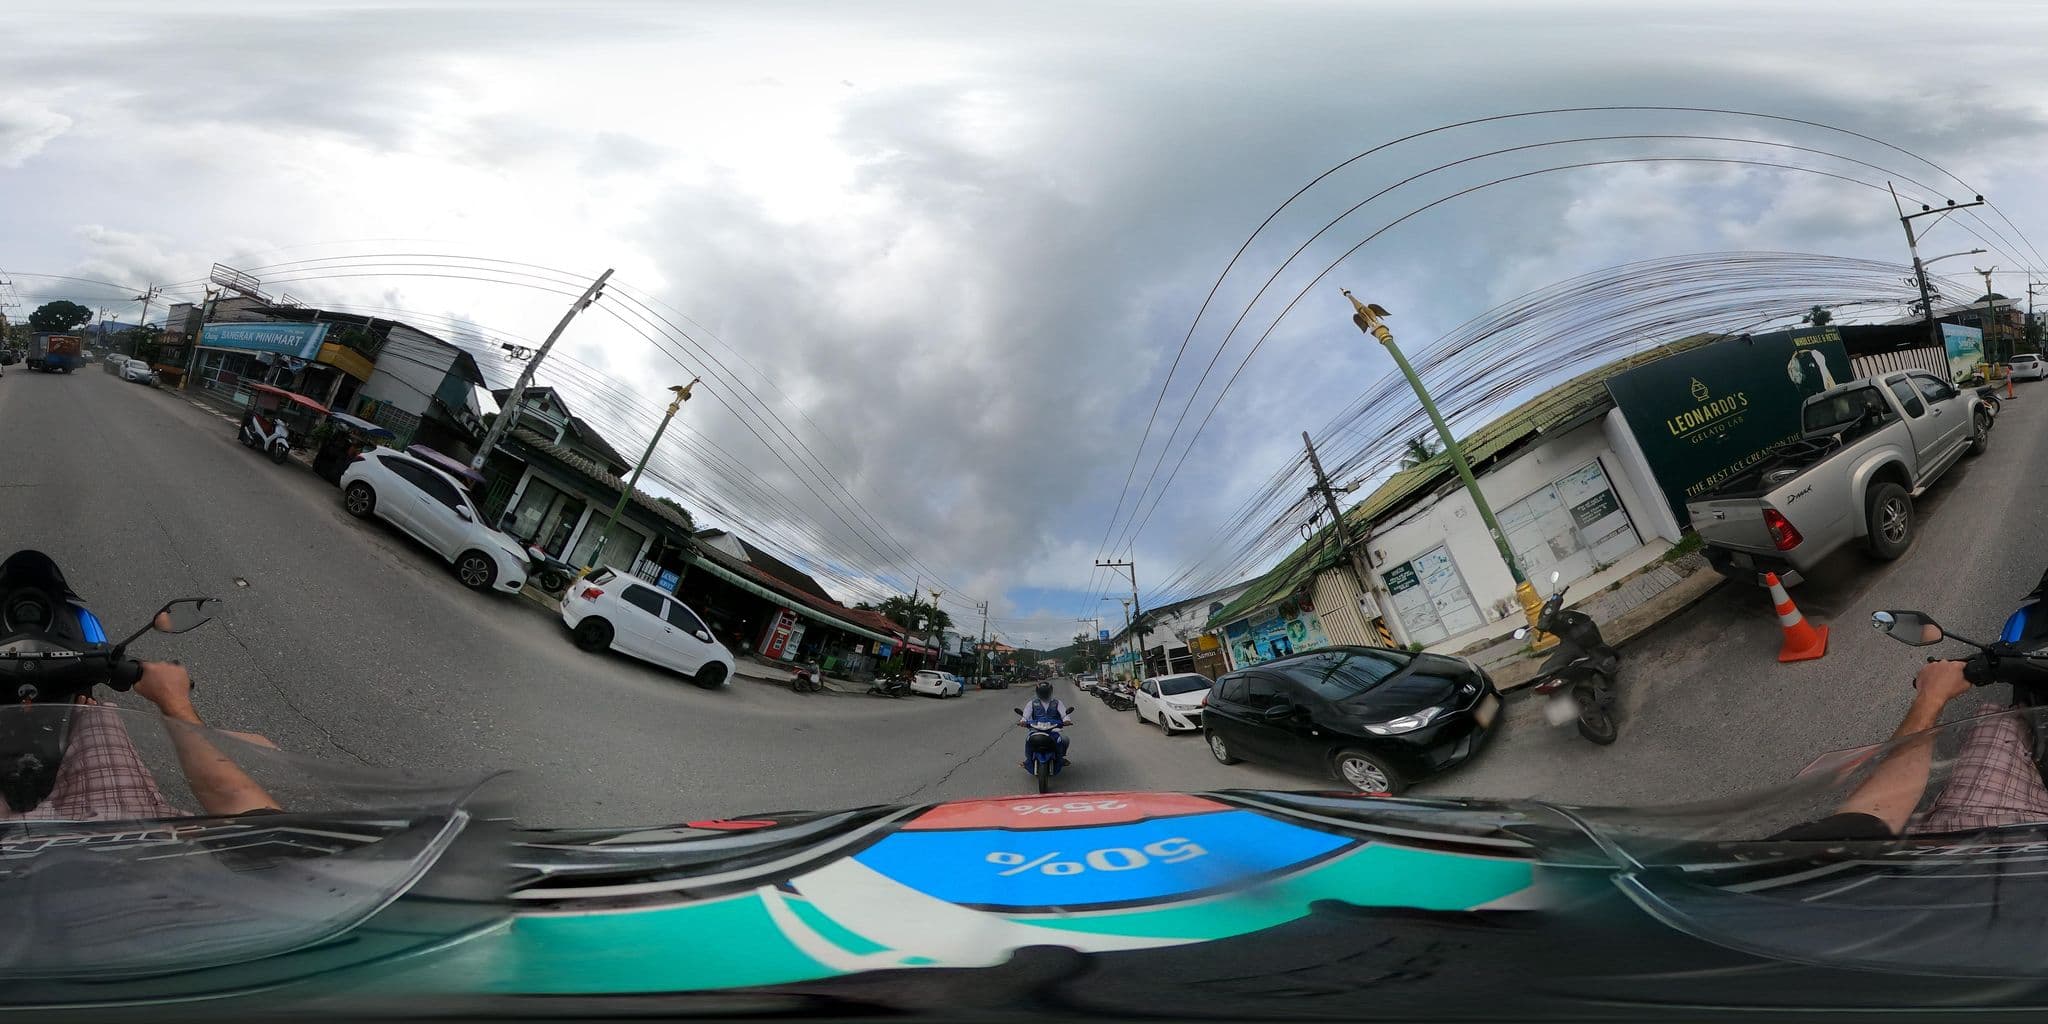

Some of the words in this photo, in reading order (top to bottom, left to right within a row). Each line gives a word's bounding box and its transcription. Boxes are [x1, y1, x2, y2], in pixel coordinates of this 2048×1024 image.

[255, 331, 302, 347] MINIMART
[1793, 335, 1821, 347] WHOLESALE
[1826, 332, 1840, 342] RETAIL
[1667, 391, 1748, 435] LEONARDO'S
[1691, 423, 1725, 444] GELATO
[1686, 481, 1706, 498] THE
[1706, 468, 1729, 486] BEST
[1730, 460, 1745, 474] ICE
[1787, 431, 1801, 444] THE
[1013, 799, 1128, 816] 25%
[985, 837, 1208, 876] 50%
